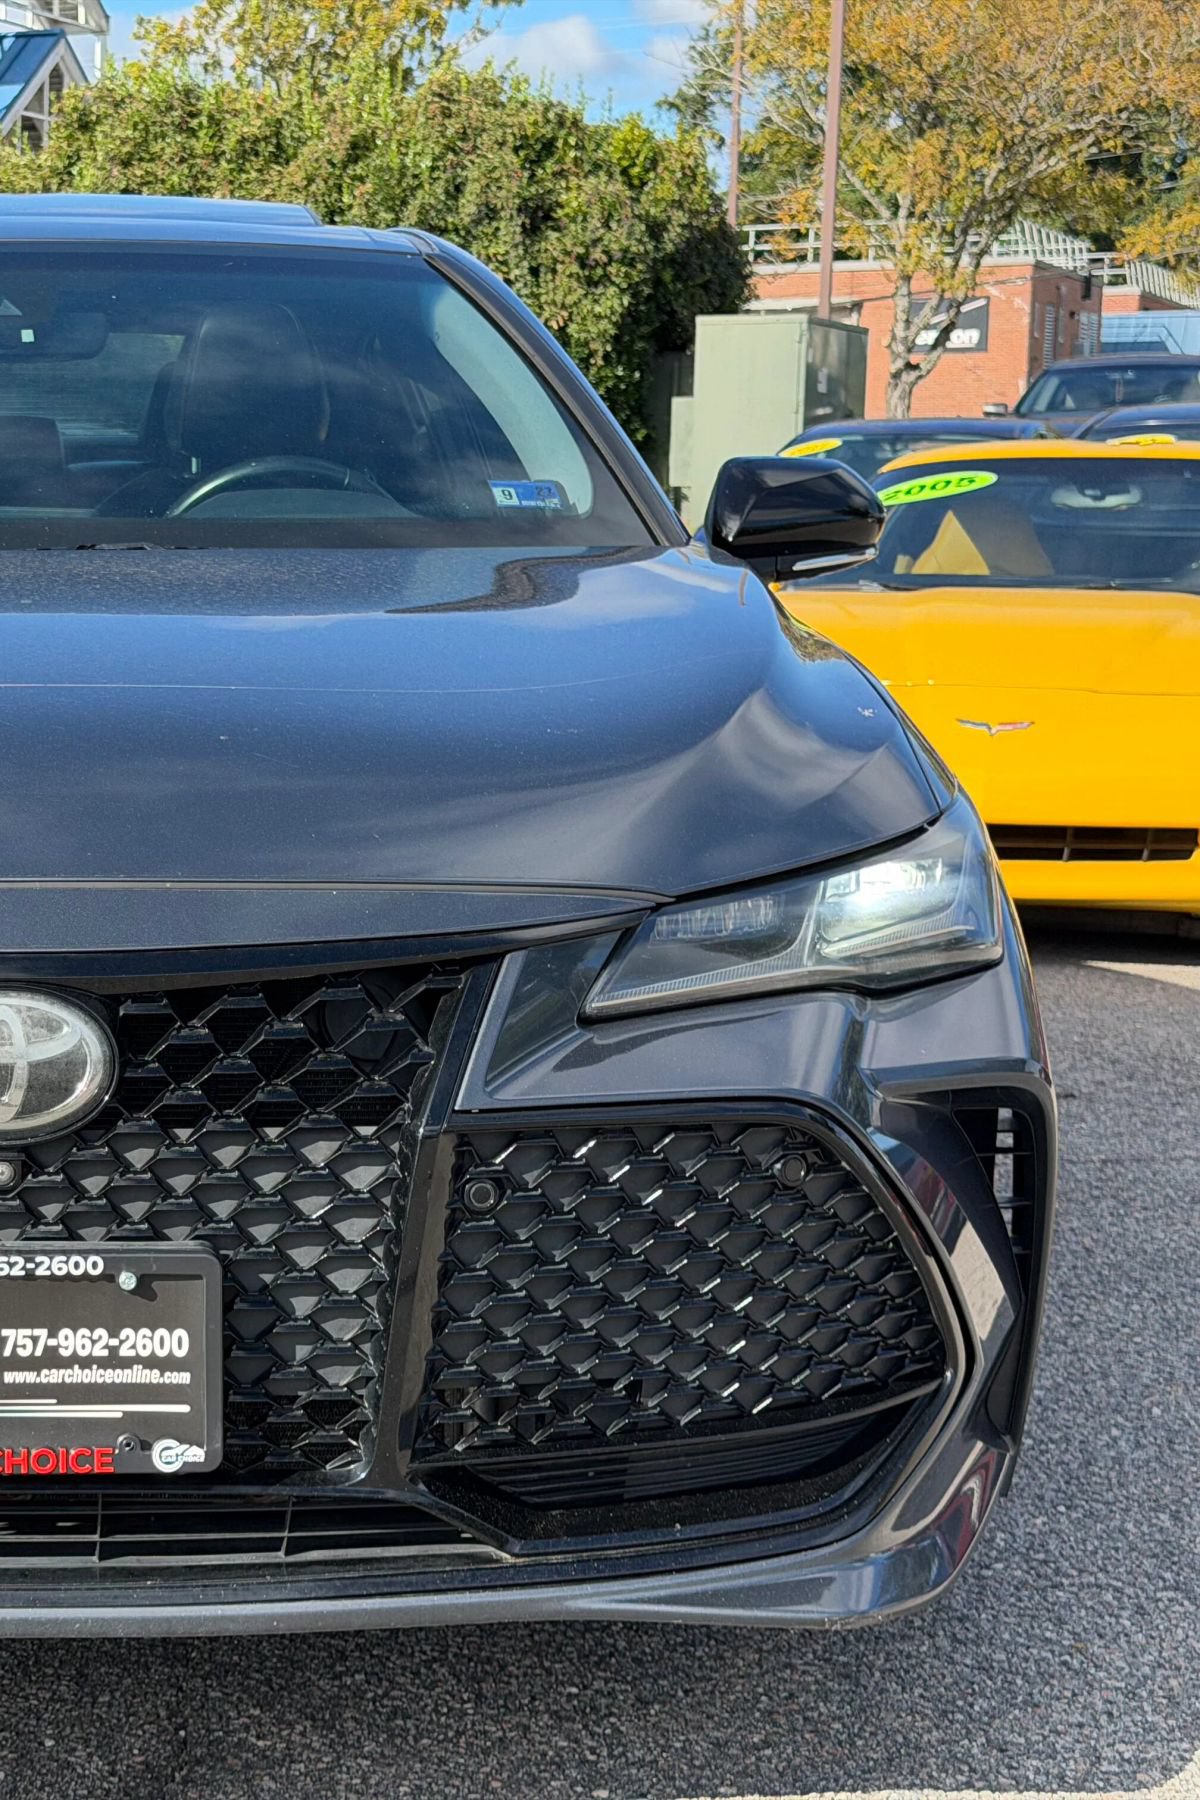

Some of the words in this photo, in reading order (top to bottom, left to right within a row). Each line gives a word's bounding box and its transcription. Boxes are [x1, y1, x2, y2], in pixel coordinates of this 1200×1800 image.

[501, 489, 513, 500] 9
[883, 477, 976, 501] 2005
[1, 1328, 190, 1357] 757-962-2600
[3, 1364, 191, 1384] www.carchoiceonline.com
